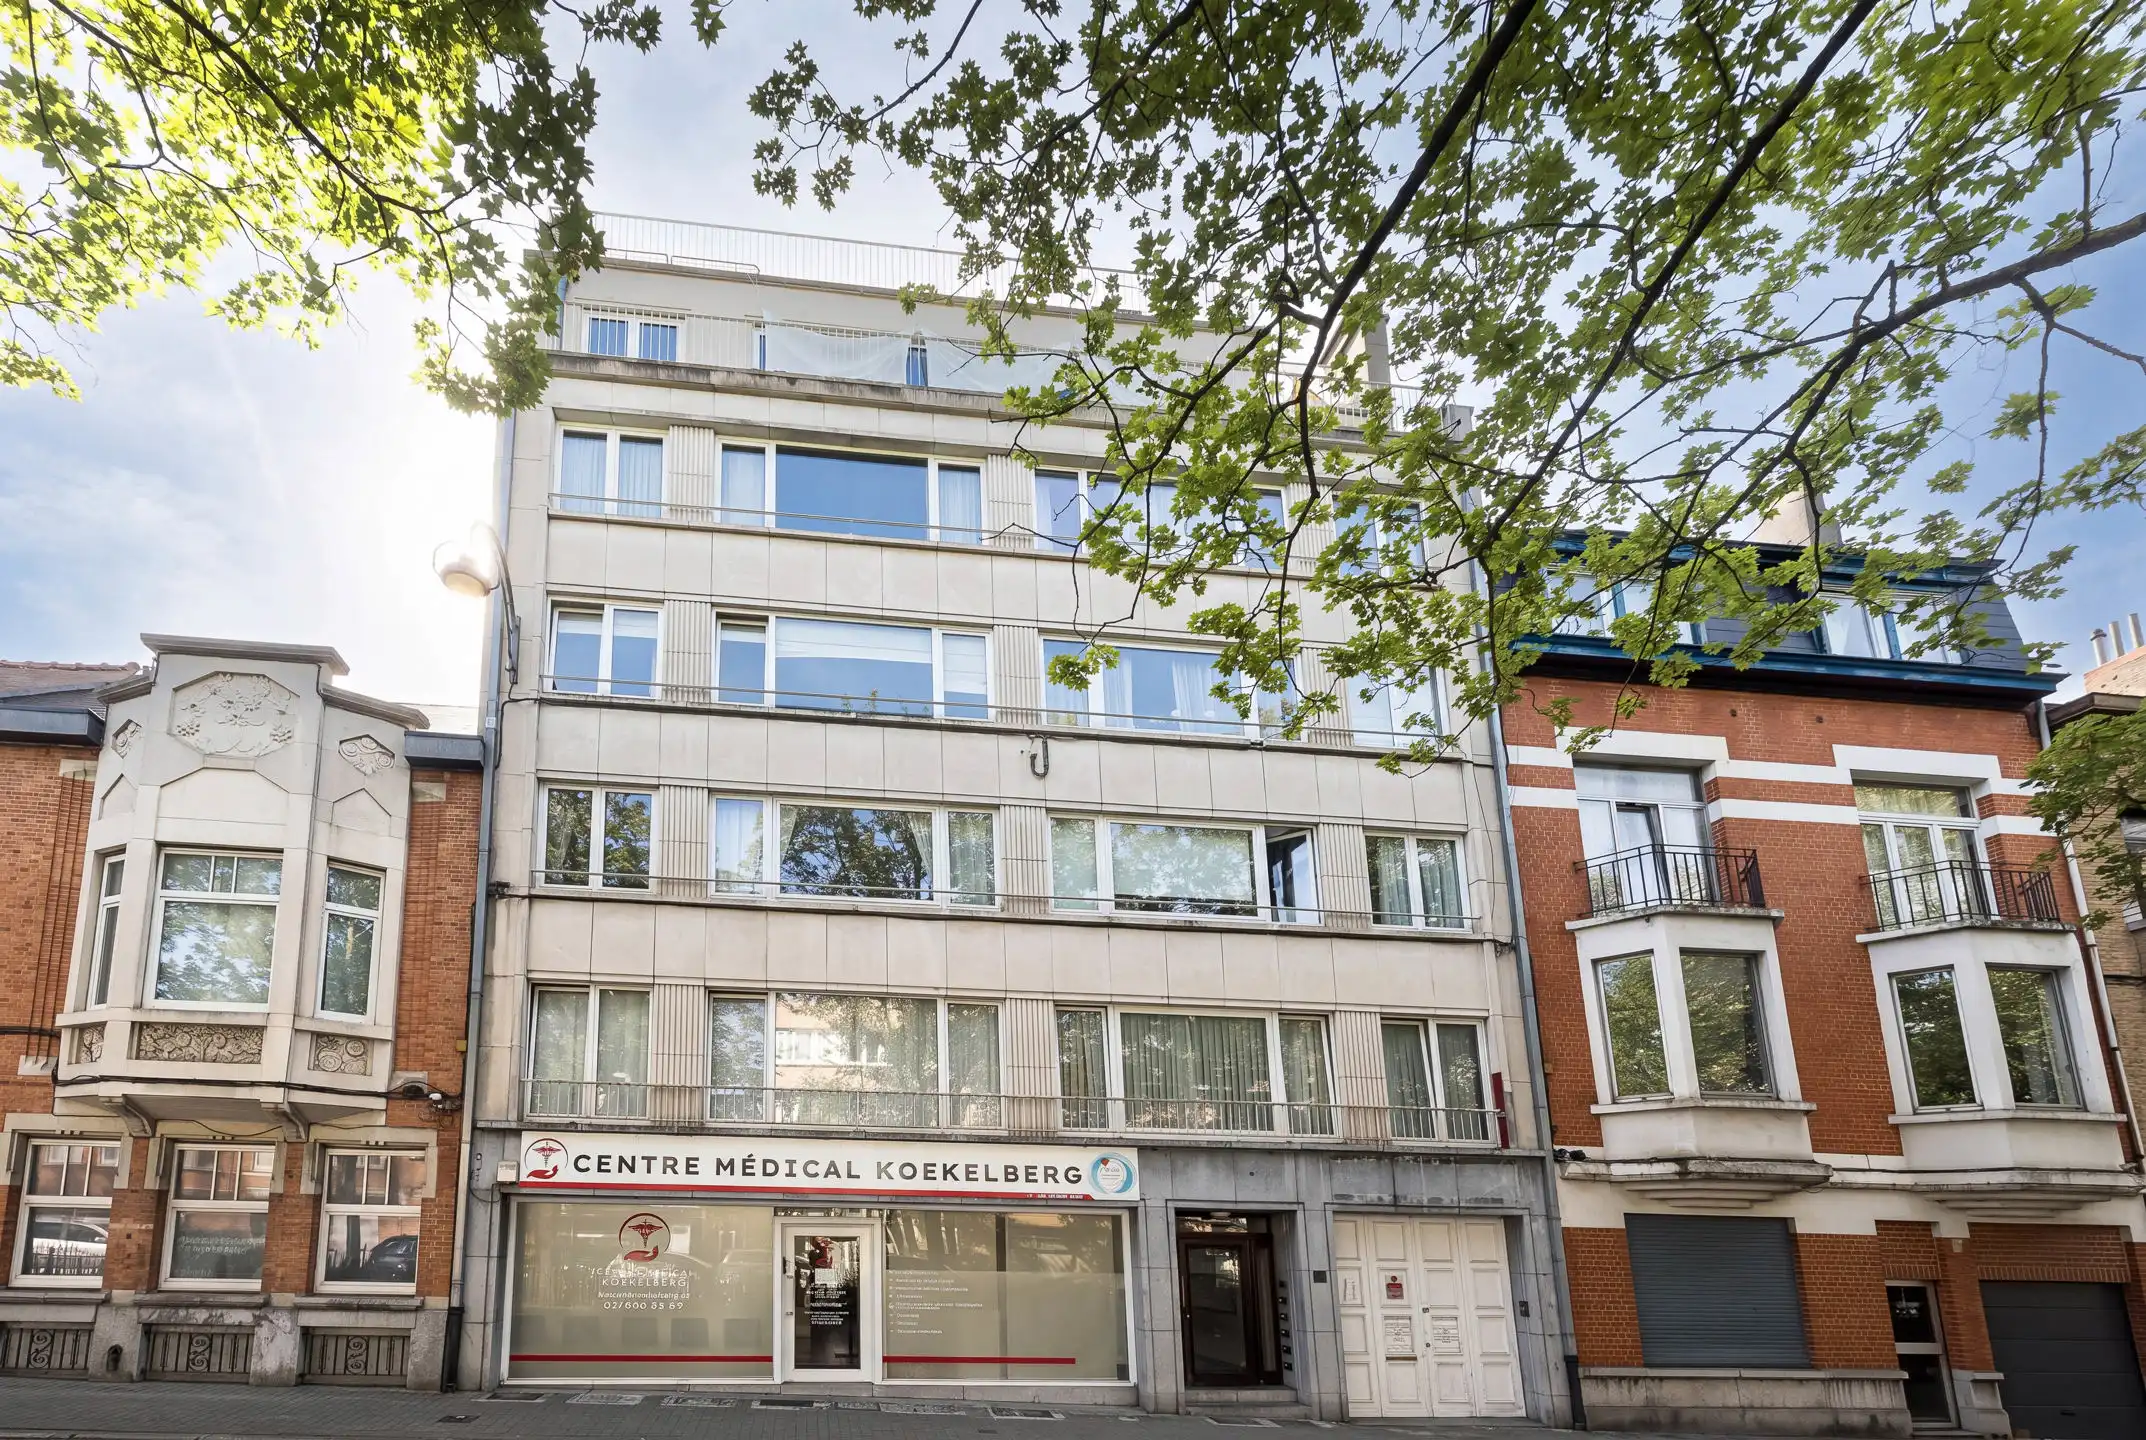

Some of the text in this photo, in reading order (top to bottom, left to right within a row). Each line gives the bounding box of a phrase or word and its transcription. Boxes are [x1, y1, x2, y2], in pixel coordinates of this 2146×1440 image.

[573, 1154, 700, 1176] CENTRE
[715, 1153, 861, 1179] MÉDICAL
[876, 1160, 1083, 1185] KOEKELBERG
[602, 1278, 687, 1287] KOEKELBERG
